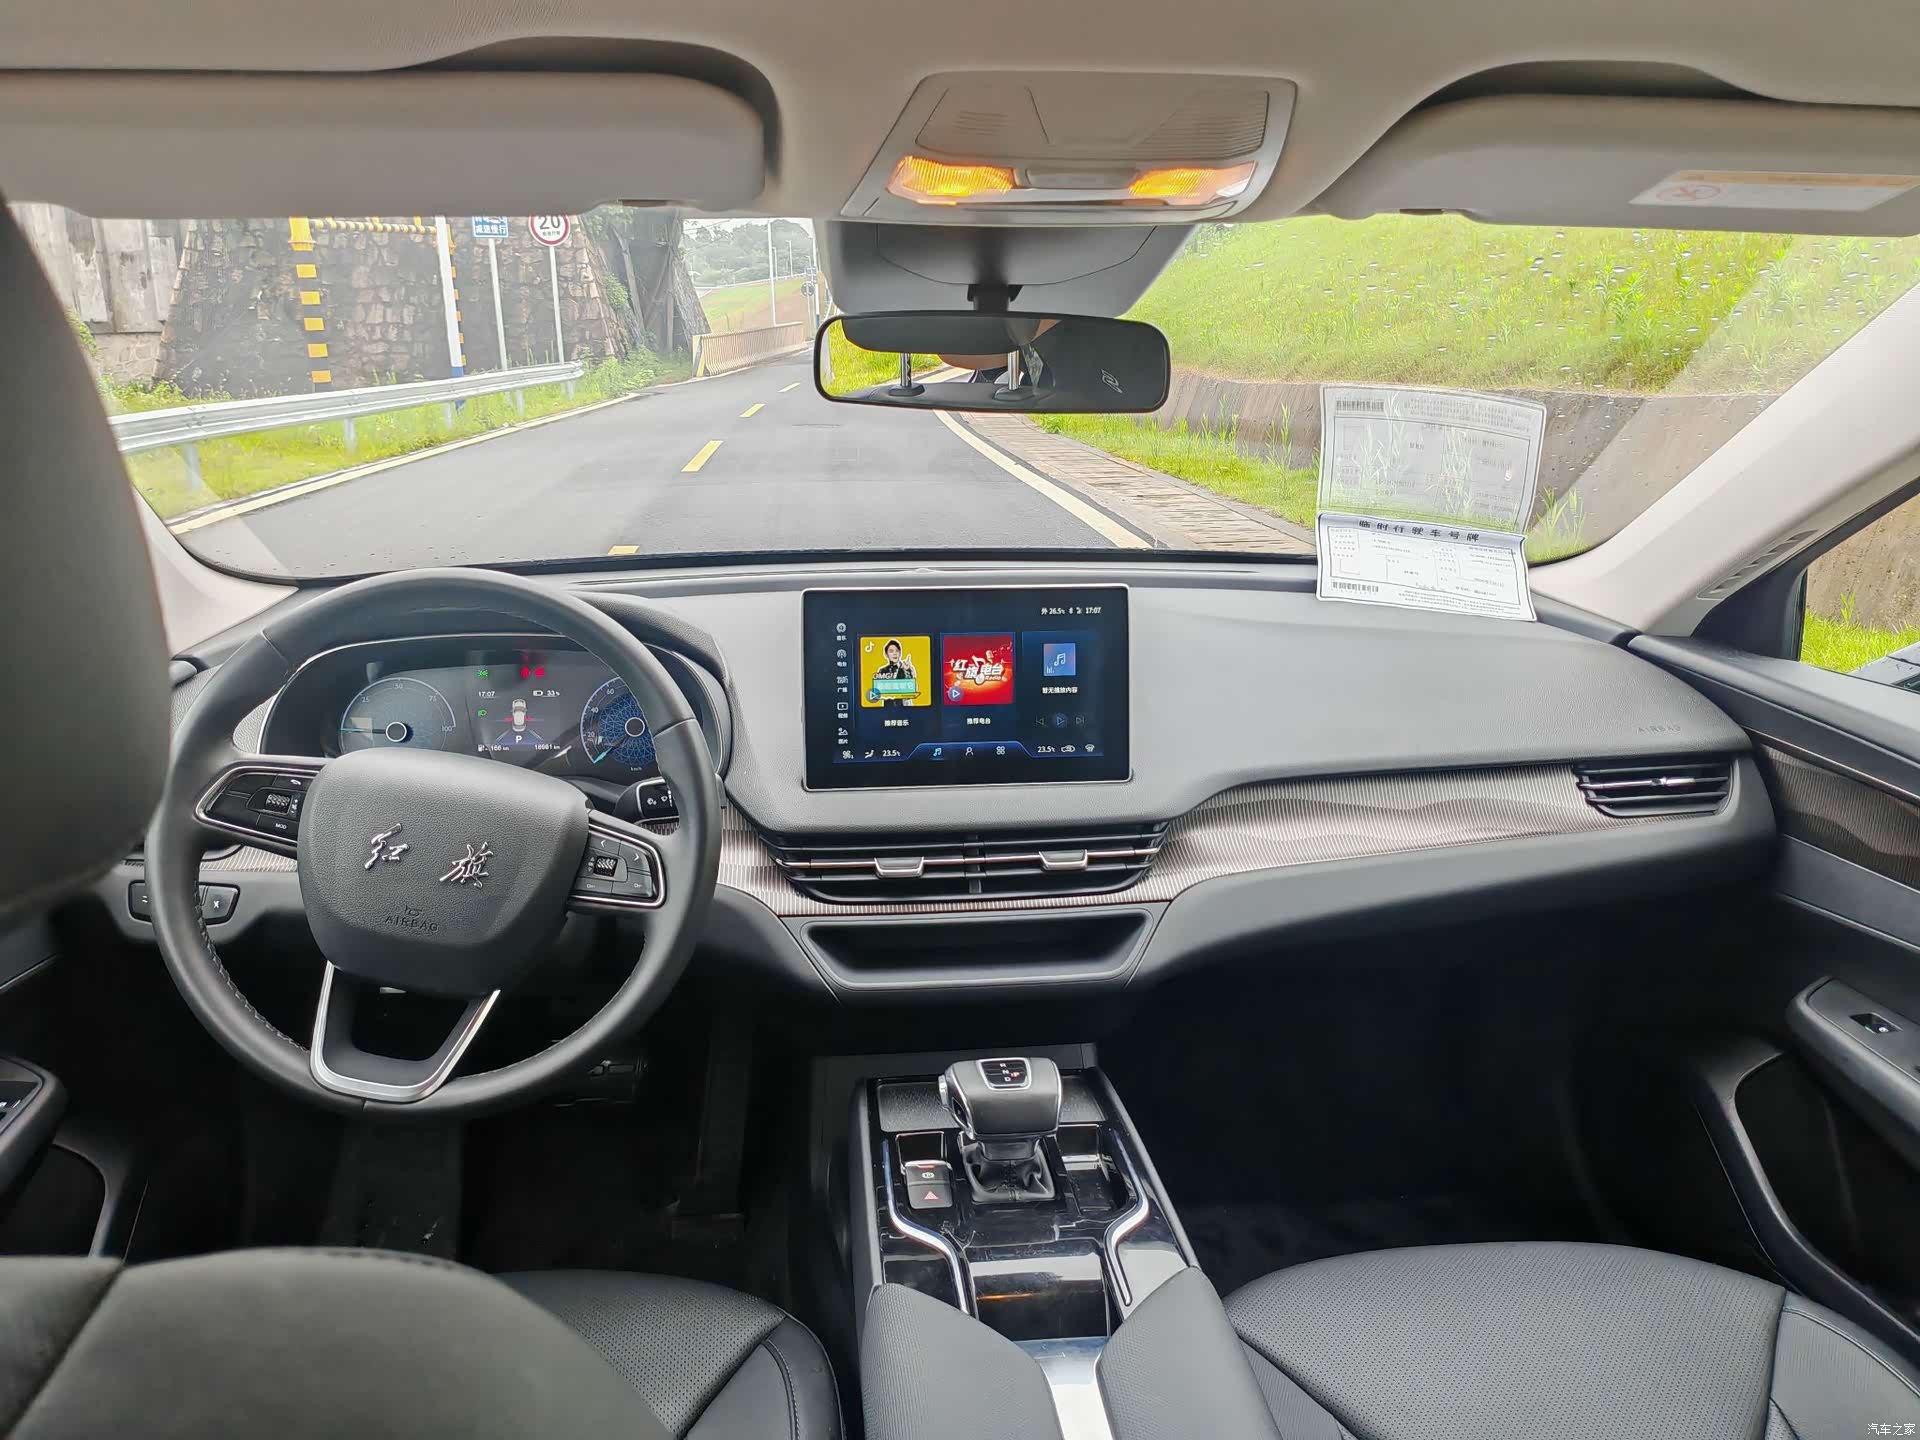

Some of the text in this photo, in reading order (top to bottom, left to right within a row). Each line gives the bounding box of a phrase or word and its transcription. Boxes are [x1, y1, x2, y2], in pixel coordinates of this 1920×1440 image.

[540, 215, 561, 230] 20
[1359, 520, 1480, 542] 临时行驶车号牌
[1086, 606, 1102, 614] 17:07
[515, 735, 523, 744] P
[384, 915, 439, 933] AIRBAG
